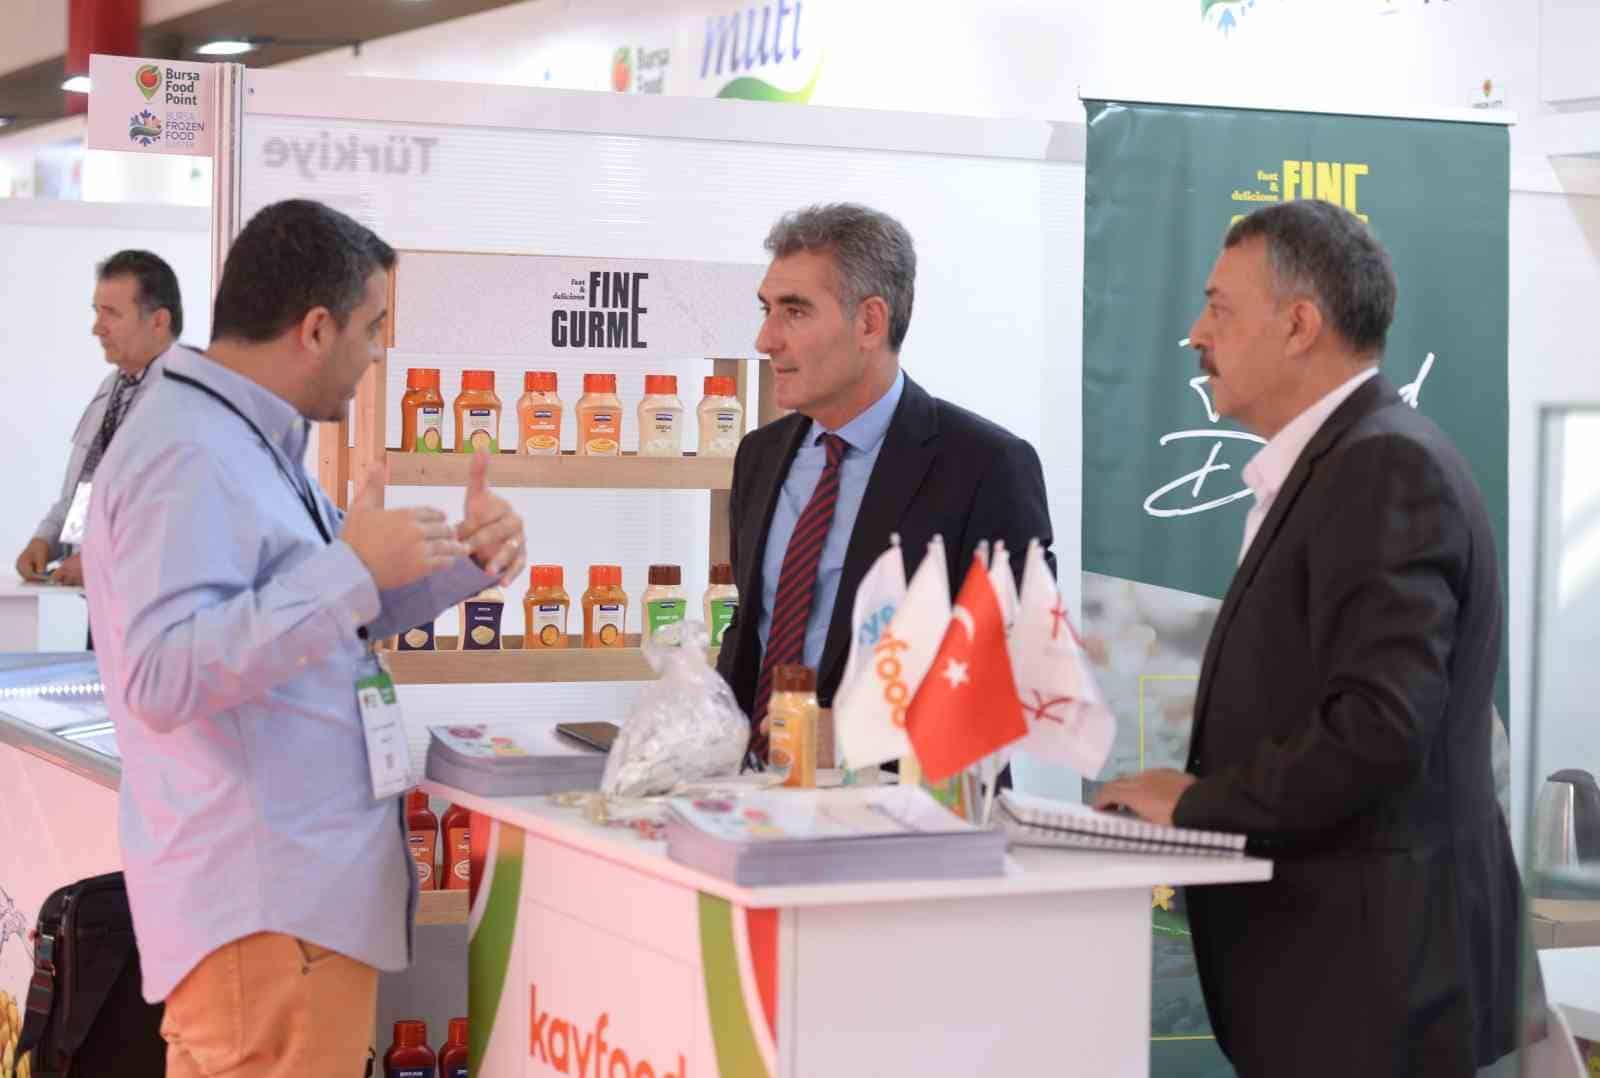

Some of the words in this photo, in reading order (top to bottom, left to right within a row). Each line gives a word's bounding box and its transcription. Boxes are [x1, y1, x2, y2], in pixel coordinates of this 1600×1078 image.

[165, 67, 201, 82] Bursa
[165, 80, 195, 94] Food
[165, 93, 198, 107] Point
[165, 120, 205, 133] FROZEN
[165, 131, 194, 142] FOOD
[588, 271, 649, 314] FINE
[551, 309, 648, 349] GURME
